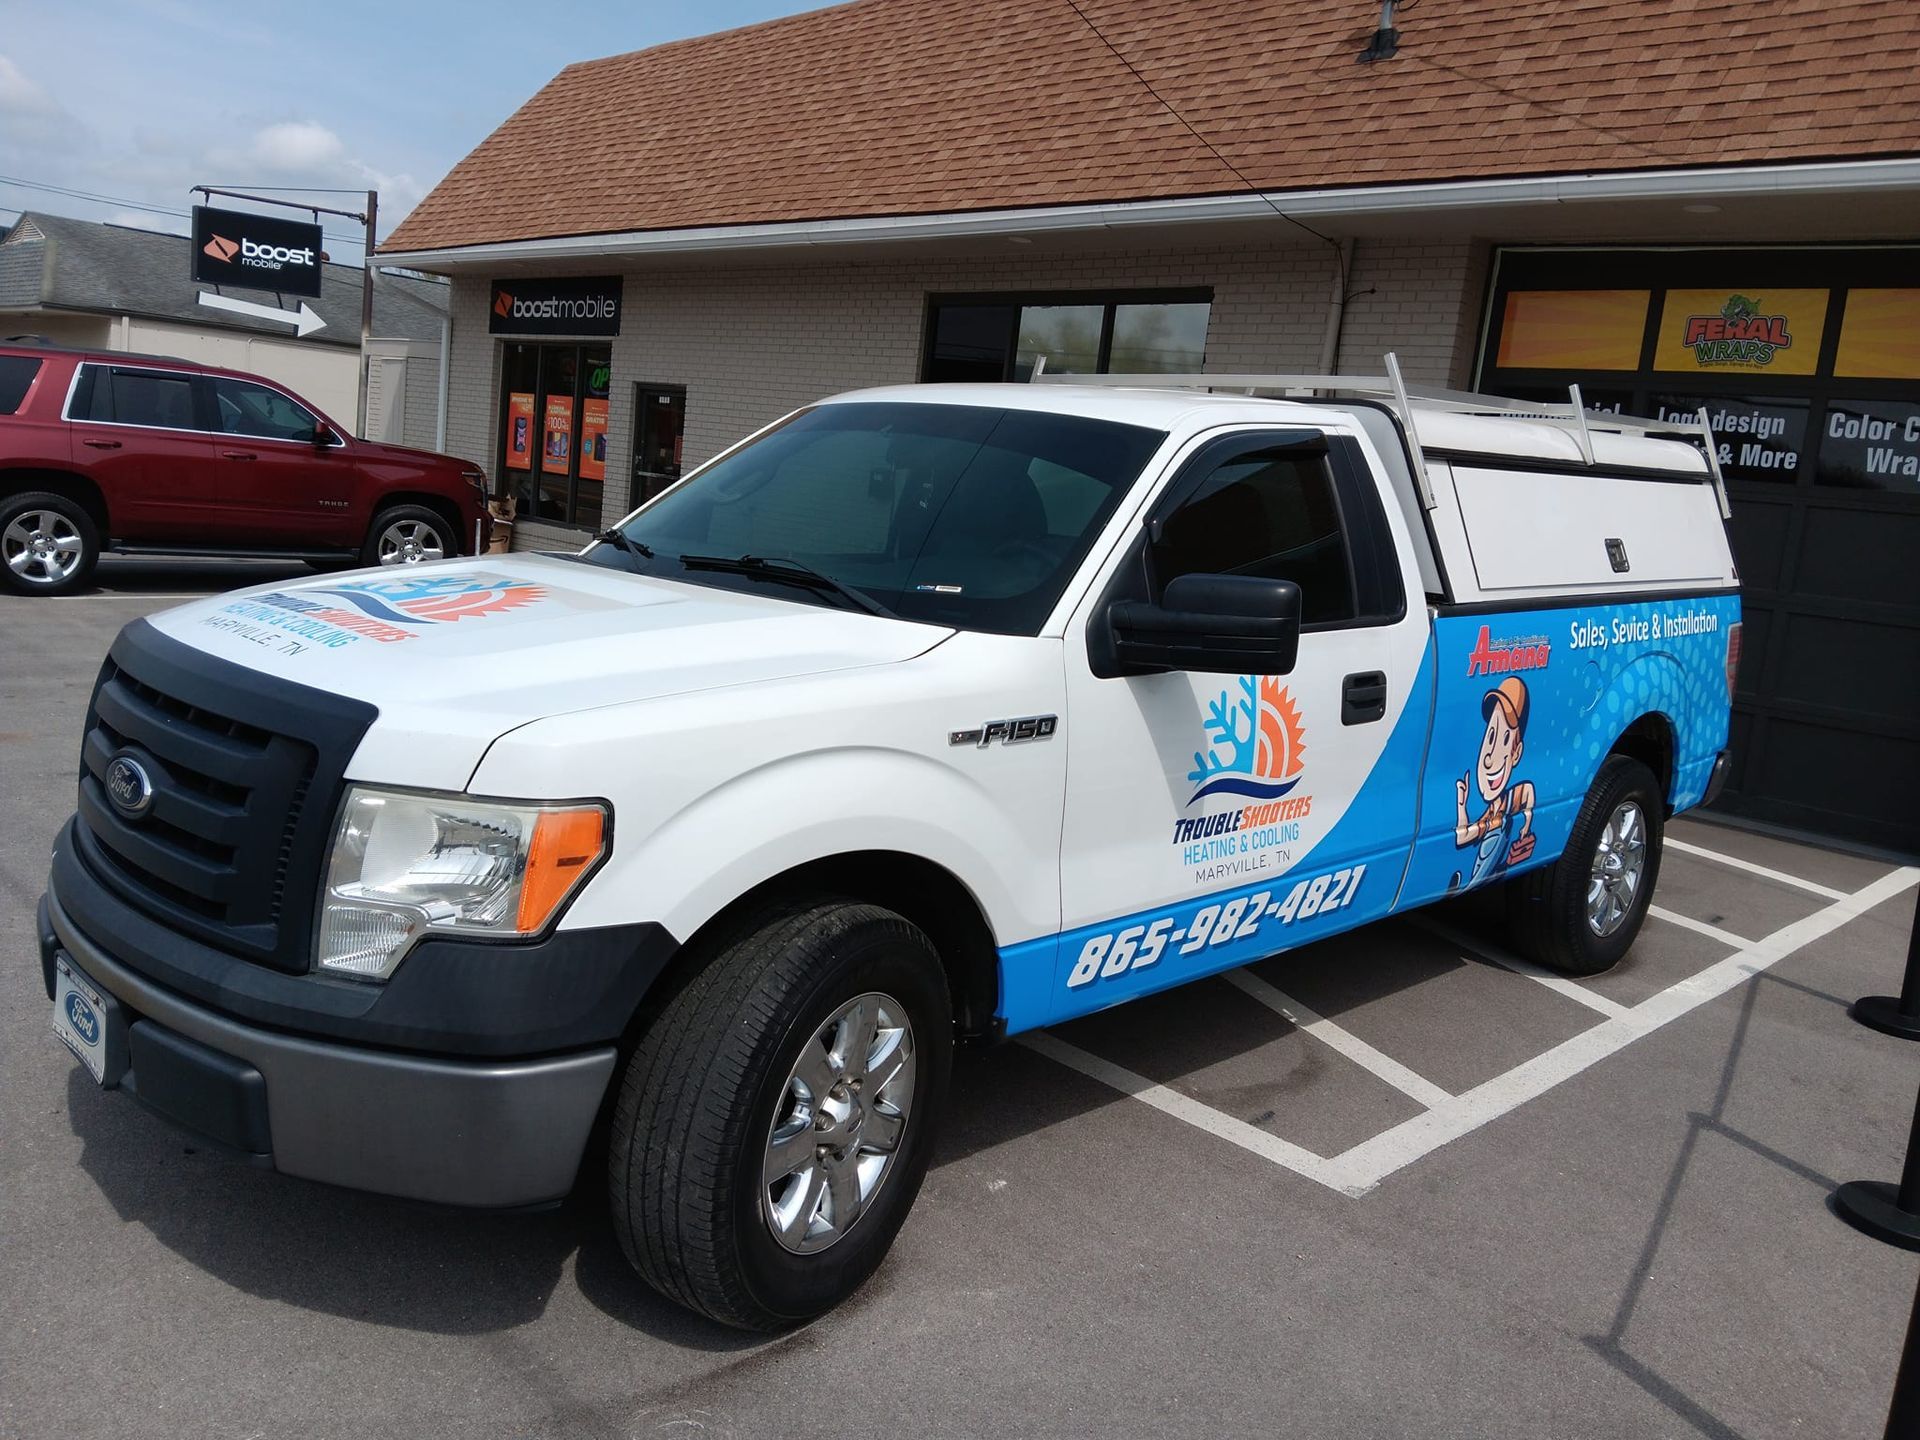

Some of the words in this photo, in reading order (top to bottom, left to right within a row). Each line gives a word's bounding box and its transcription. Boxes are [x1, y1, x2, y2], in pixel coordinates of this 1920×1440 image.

[241, 237, 314, 267] boost
[241, 256, 281, 270] mobile
[513, 295, 616, 319] boostmobile
[1684, 316, 1791, 348] FERAL
[1694, 340, 1775, 362] WRAPS
[1711, 409, 1786, 440] design
[1828, 411, 1897, 441] Color
[1716, 443, 1733, 465] &
[1739, 443, 1798, 470] More
[1866, 447, 1920, 482] Wra
[318, 499, 349, 508] TAHOE
[281, 615, 360, 648] COOLING
[1569, 618, 1609, 650] Sales,
[1611, 615, 1650, 645] Sevice
[1651, 612, 1661, 638] &
[1663, 608, 1718, 638] Installation
[277, 641, 310, 656] TN
[1466, 624, 1551, 677] Amana
[110, 763, 138, 800] Ford
[1183, 835, 1236, 866] HEATING
[1240, 834, 1249, 853] &
[1252, 822, 1300, 851] COOLING
[1195, 855, 1272, 884] MARYVILLE,
[1275, 848, 1291, 864] TN
[1066, 864, 1367, 989] 865-982-4821
[71, 997, 95, 1038] Ford
